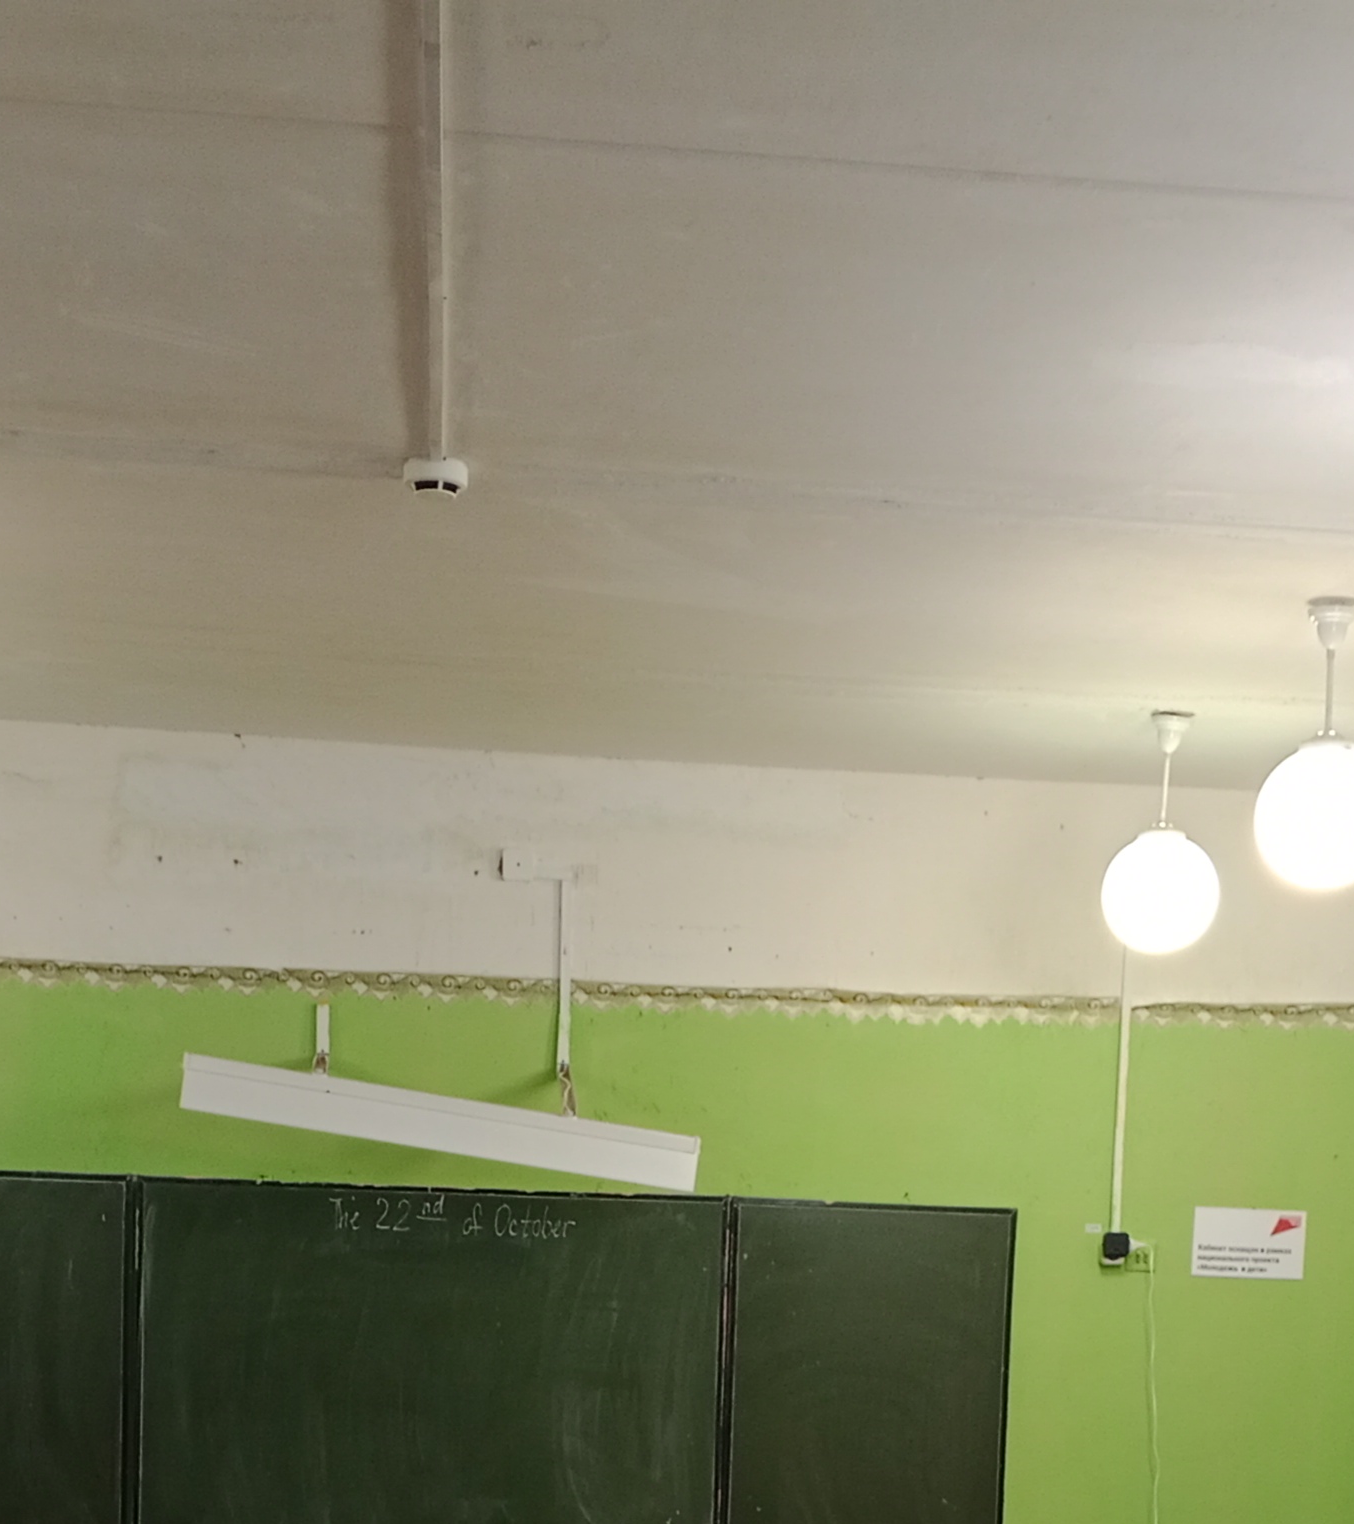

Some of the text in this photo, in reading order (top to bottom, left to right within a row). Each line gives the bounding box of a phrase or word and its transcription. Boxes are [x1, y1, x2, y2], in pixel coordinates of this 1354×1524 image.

[329, 1196, 360, 1230] The
[462, 1202, 483, 1236] of
[494, 1203, 576, 1239] October
